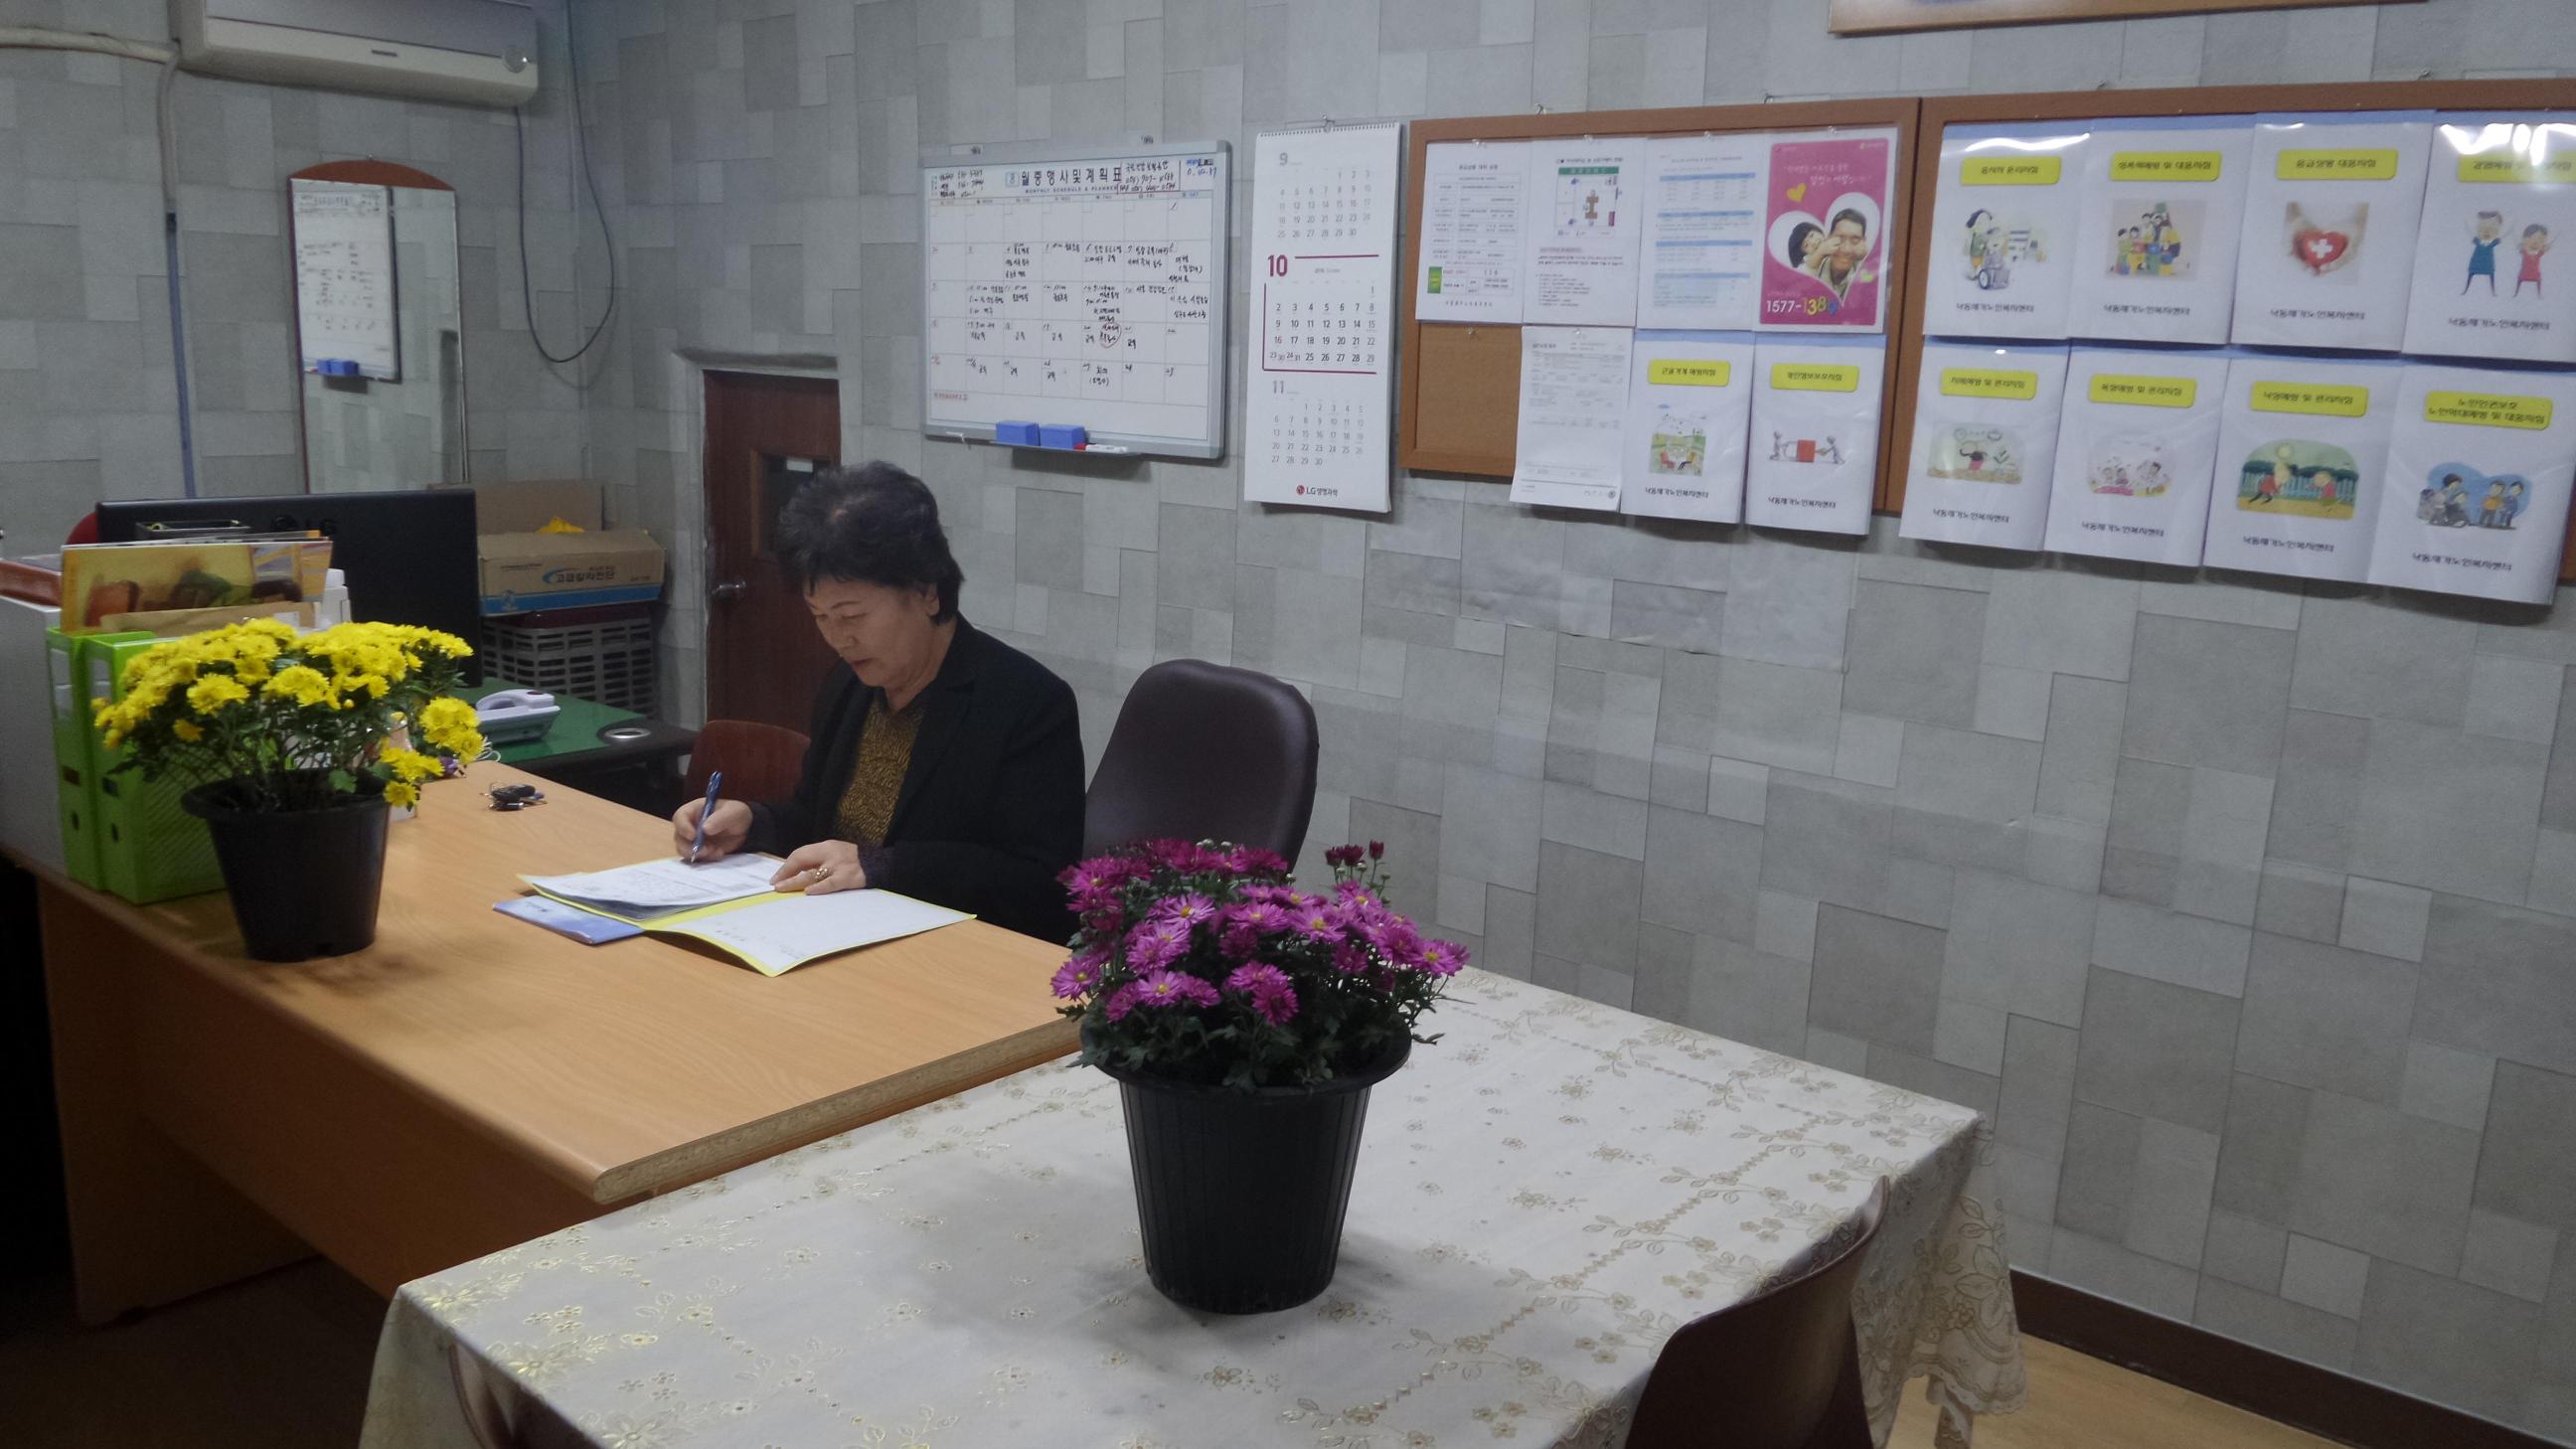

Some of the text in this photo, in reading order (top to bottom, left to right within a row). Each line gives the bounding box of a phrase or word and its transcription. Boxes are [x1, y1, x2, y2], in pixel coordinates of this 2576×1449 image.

[1279, 152, 1288, 166] 9
[1267, 254, 1288, 277] 10
[1276, 319, 1281, 328] 9
[1367, 337, 1375, 346] 22
[1321, 353, 1330, 362] 26
[1337, 354, 1346, 363] 27
[1352, 354, 1361, 363] 28
[1367, 354, 1374, 363] 29
[1273, 380, 1284, 395] 11
